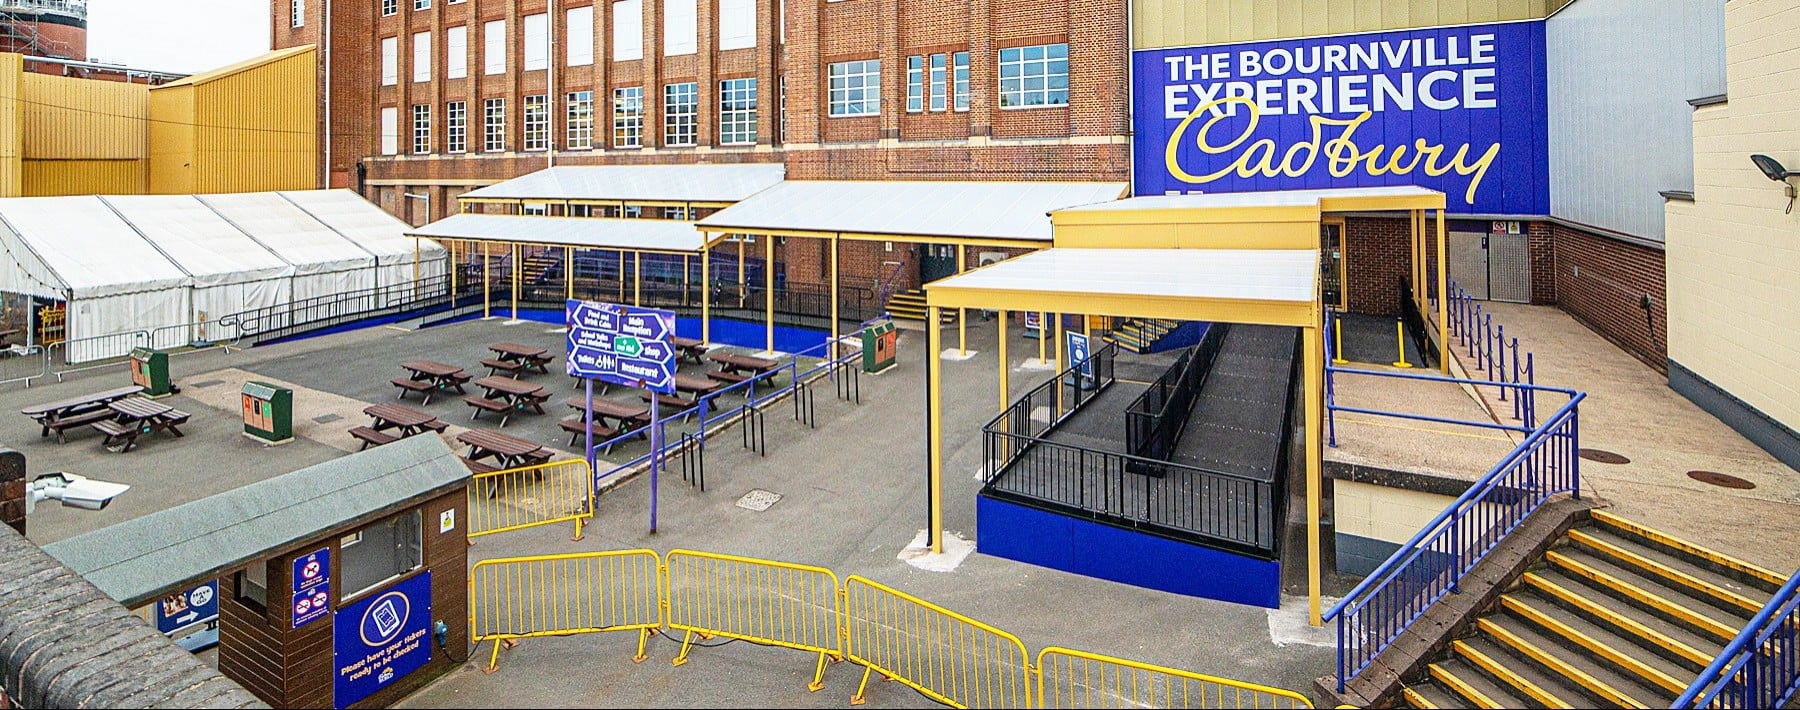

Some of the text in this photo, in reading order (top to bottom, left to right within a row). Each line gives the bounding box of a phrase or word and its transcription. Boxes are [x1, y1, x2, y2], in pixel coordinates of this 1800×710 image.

[1164, 33, 1496, 82] THE BOURNVILLE
[1164, 67, 1497, 119] EXPERIENCE
[1165, 97, 1501, 204] Cadbury
[622, 324, 652, 337] Reception
[628, 316, 644, 327] Main
[577, 354, 594, 364] Toilets
[622, 362, 658, 378] Restaurant
[341, 659, 366, 676] Please
[366, 650, 385, 663] have
[386, 640, 402, 655] your
[404, 628, 427, 644] tickets
[350, 666, 372, 682] ready
[373, 661, 382, 670] to
[382, 656, 392, 666] be
[392, 640, 420, 659] checked
